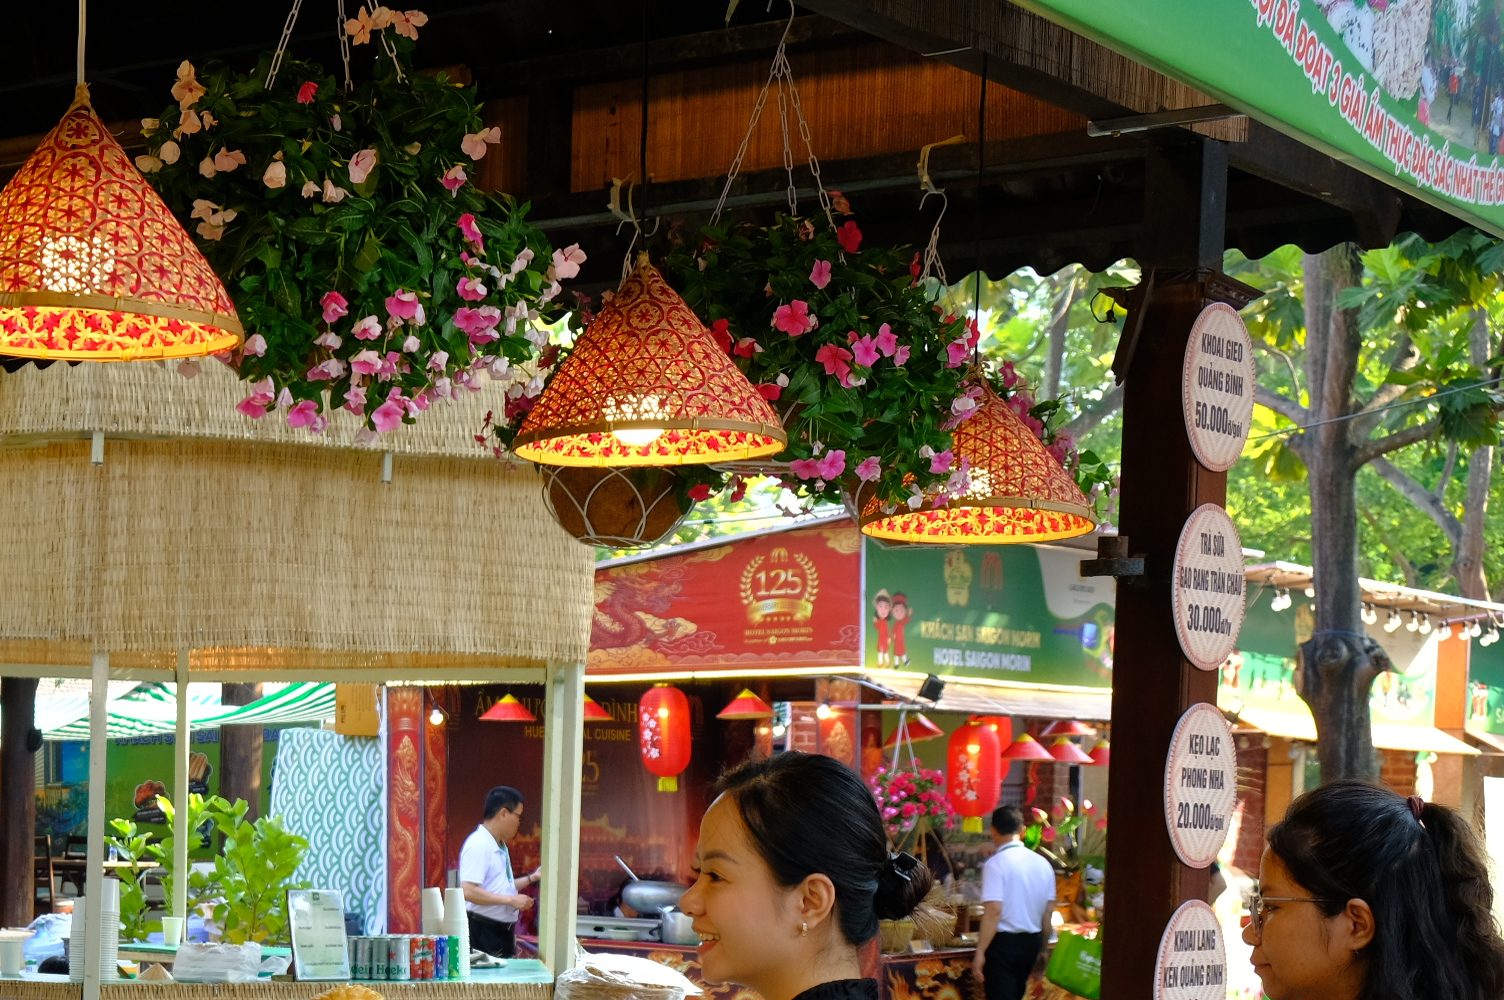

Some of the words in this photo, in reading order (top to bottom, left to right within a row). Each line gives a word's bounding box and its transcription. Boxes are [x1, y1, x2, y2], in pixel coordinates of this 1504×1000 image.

[1295, 20, 1333, 93] ĐOẠT
[1329, 62, 1342, 105] 3
[1340, 74, 1367, 132] GIẢI
[1363, 87, 1386, 151] ẨM
[1383, 113, 1413, 175] THỰC
[1410, 135, 1434, 187] ĐẶC
[1432, 140, 1453, 196] SẮC
[1451, 154, 1479, 203] NHẤT
[1477, 158, 1498, 205] THẾ
[1202, 333, 1225, 358] KHOAI
[1226, 340, 1243, 363] GIEO
[1198, 362, 1224, 391] QUẢNG
[1225, 370, 1243, 396] BÌNH
[1200, 529, 1212, 555] TRÀ
[1213, 532, 1225, 557] SỮA
[756, 569, 803, 596] 125
[1180, 566, 1192, 593] GẠO
[1193, 567, 1209, 591] RANG
[1211, 568, 1225, 593] TRÂN
[1227, 570, 1243, 596] CHÂU
[921, 617, 954, 640] KHÁCH
[956, 624, 974, 647] SẠN
[976, 626, 1011, 646] SAIGON
[1012, 630, 1041, 649] MORIN
[1187, 604, 1232, 636] 30.000đ/ly
[933, 647, 964, 667] HOTEL
[965, 650, 1000, 670] SAIGON
[1001, 653, 1031, 672] MORIN
[596, 729, 631, 741] CUISINE
[1189, 734, 1204, 759] KẸO
[1206, 735, 1220, 760] LẠC
[1181, 767, 1207, 788] PHONG
[1209, 769, 1224, 790] NHA
[1174, 930, 1196, 952] KHOAI
[1197, 929, 1216, 951] LANG
[1180, 958, 1204, 989] QUẢNG
[1206, 960, 1223, 985] BÌNH
